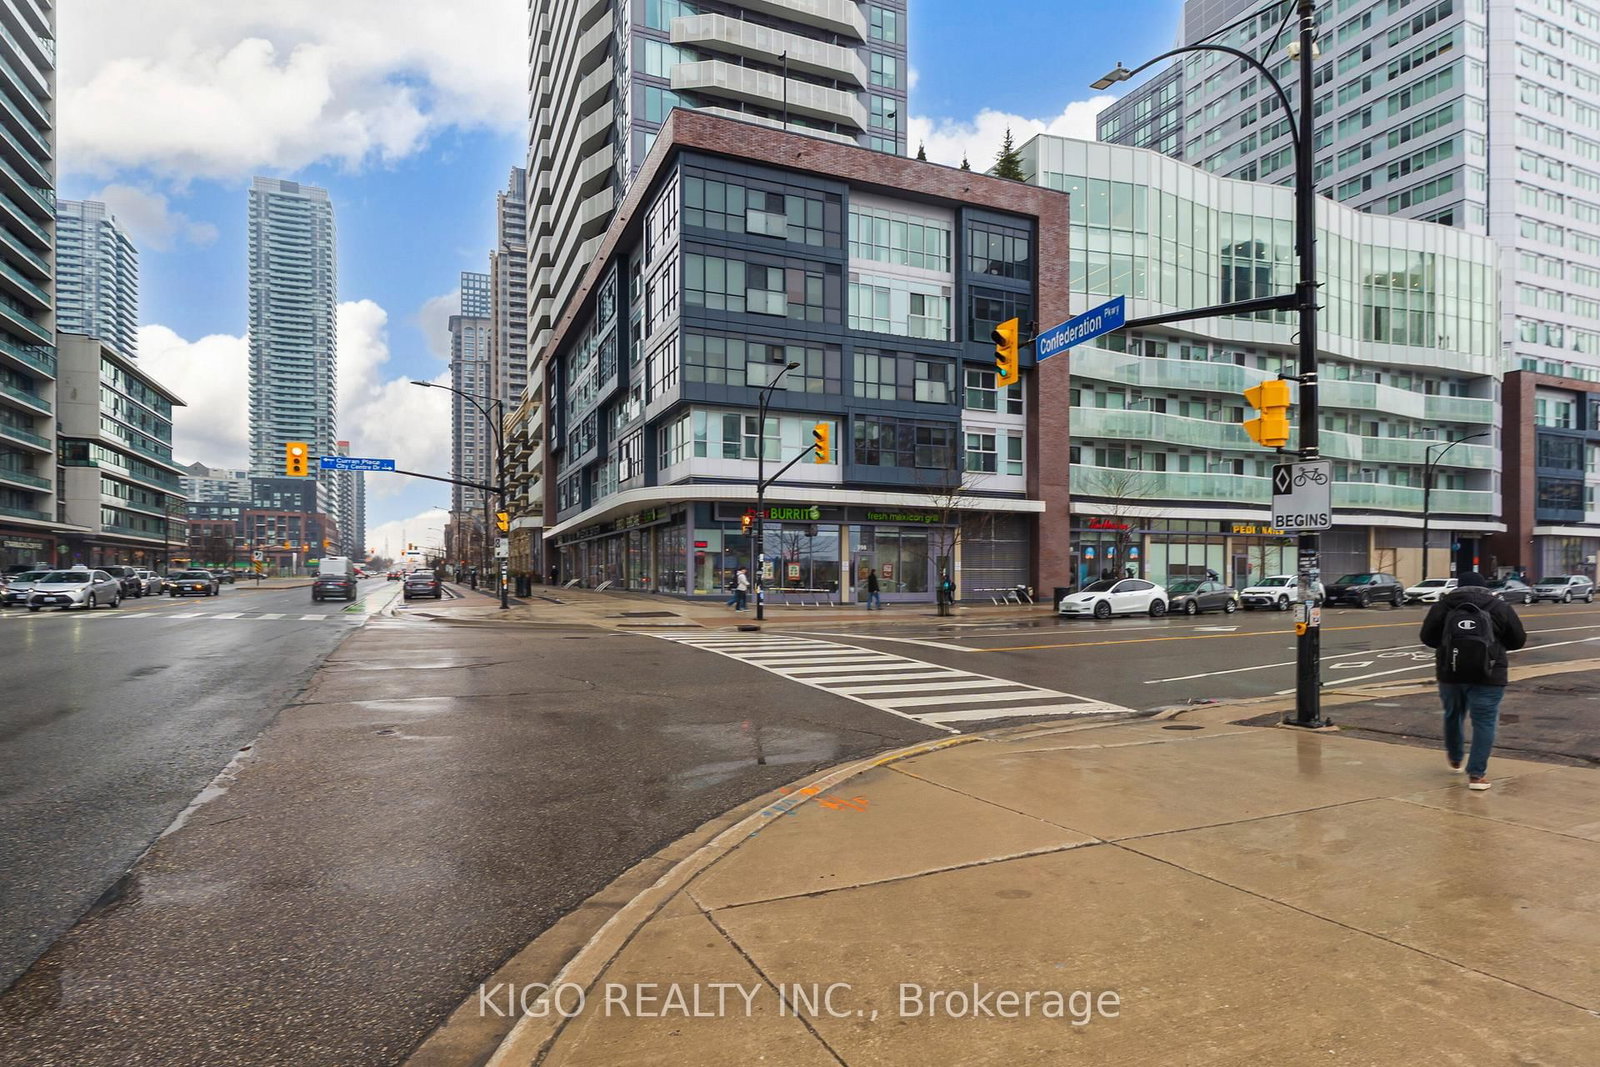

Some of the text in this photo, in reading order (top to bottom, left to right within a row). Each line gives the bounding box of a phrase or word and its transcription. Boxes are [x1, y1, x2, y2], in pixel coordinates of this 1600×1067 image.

[1040, 305, 1120, 354] Confederation Pkwy
[867, 511, 888, 520] fresh
[889, 513, 924, 522] mexican
[1275, 513, 1328, 527] BEGINS
[1232, 525, 1256, 534] PEDI
